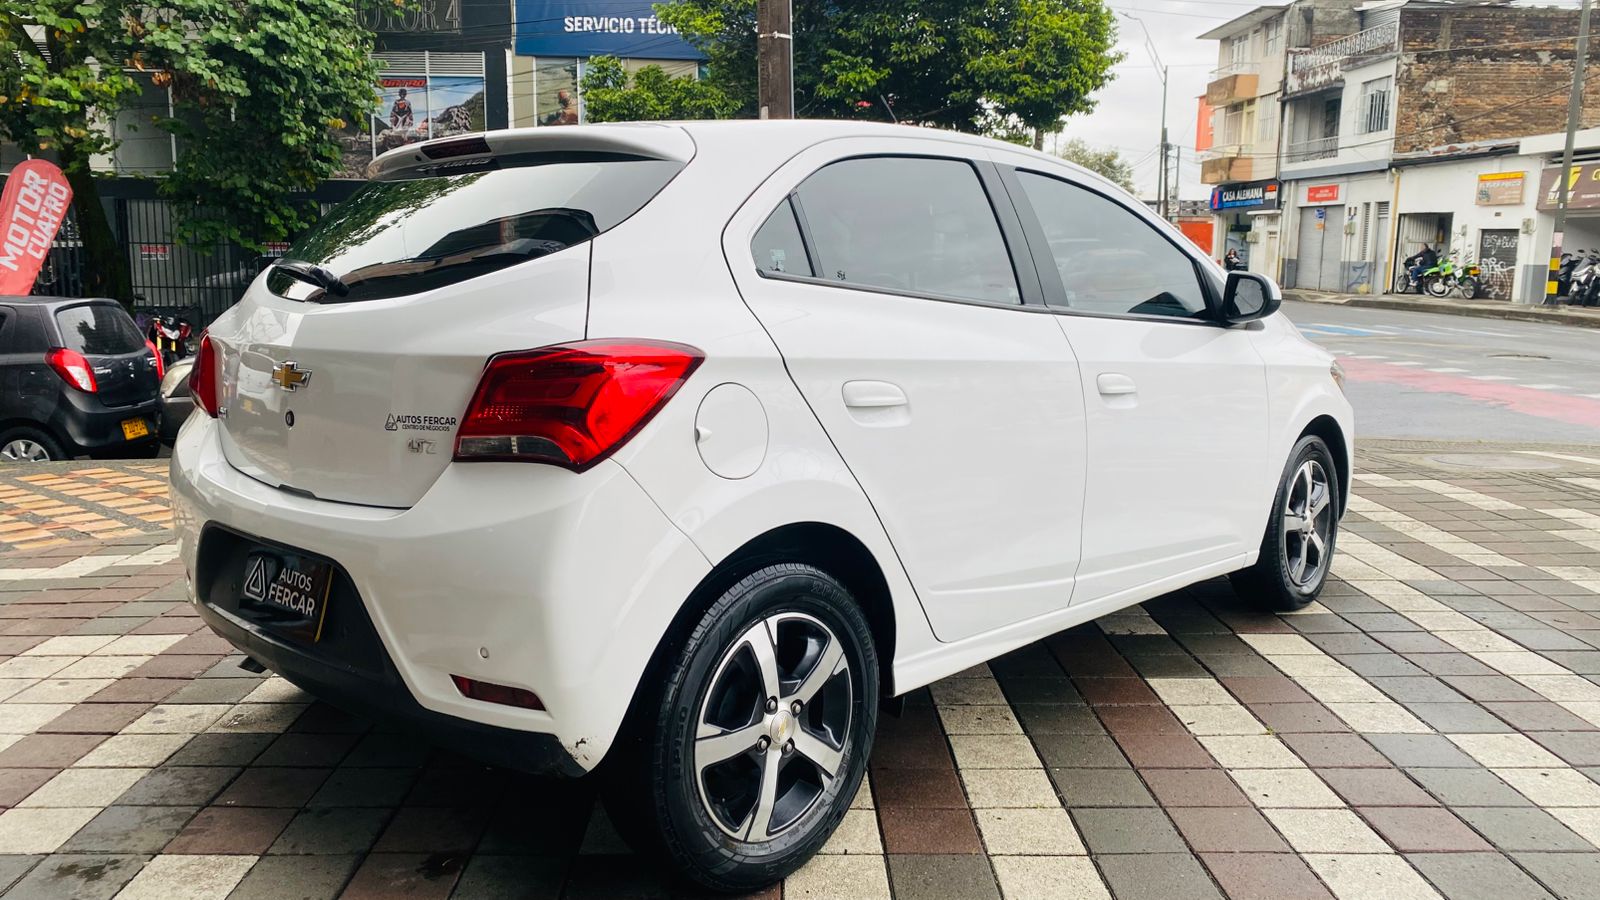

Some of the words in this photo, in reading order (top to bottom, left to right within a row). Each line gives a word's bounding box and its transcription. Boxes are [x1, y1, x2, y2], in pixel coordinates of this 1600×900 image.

[564, 16, 634, 33] SERVICIO
[1222, 190, 1236, 202] CASA
[1236, 187, 1263, 200] ALEMANA
[0, 168, 48, 271] MOTOR
[26, 181, 69, 259] CUATRO
[396, 415, 421, 424] AUTOS
[424, 416, 456, 425] FERCAR
[279, 567, 313, 592] AUTOS
[268, 583, 316, 617] FERCAR
